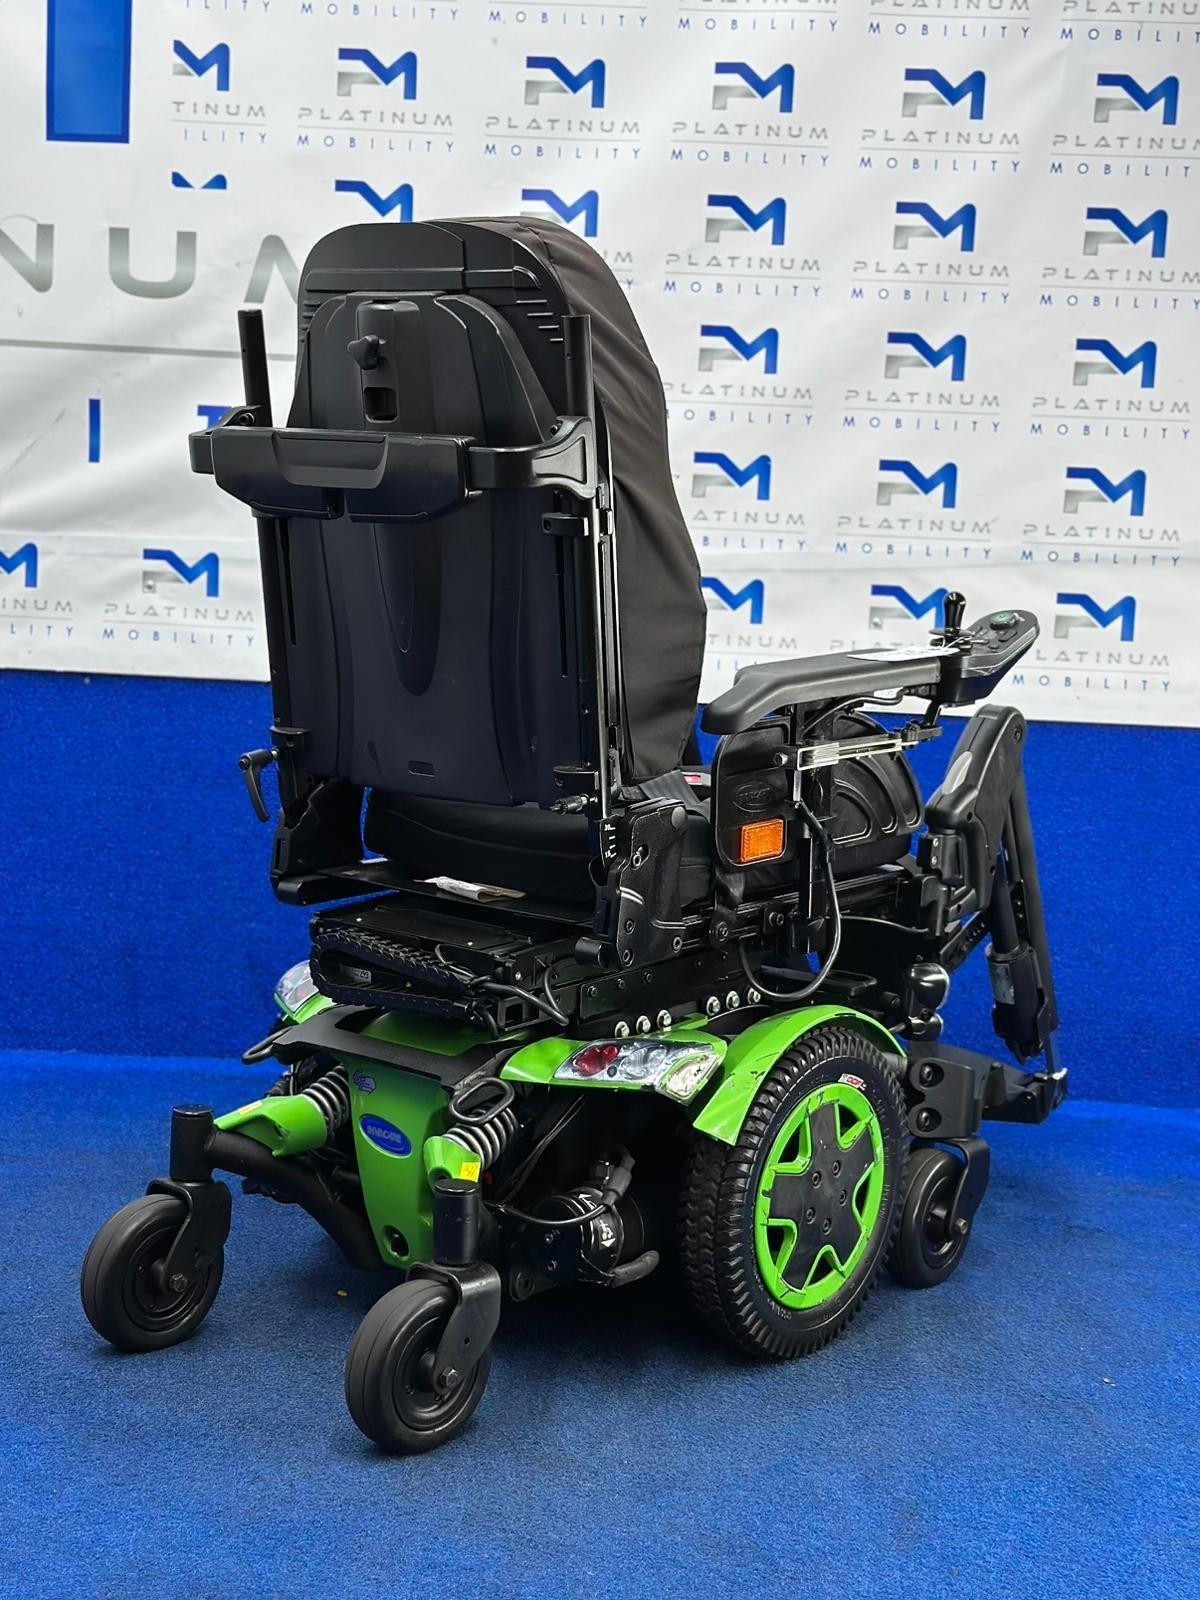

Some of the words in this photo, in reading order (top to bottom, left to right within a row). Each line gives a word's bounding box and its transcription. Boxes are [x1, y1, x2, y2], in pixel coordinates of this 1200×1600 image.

[300, 2, 458, 20] MOBILITY
[488, 11, 647, 28] MOBILITY
[678, 17, 838, 32] MOBILITY
[868, 21, 1030, 39] MOBILITY
[298, 107, 452, 126] PLATINUM
[485, 116, 639, 133] PLATINUM
[672, 122, 828, 139] PLATINUM
[861, 129, 1019, 145] PLATINUM
[297, 134, 454, 152] MOBILITY
[484, 143, 640, 159] MOBILITY
[670, 149, 829, 167] MOBILITY
[859, 156, 1020, 172] MOBILITY
[666, 253, 820, 271] PLATINUM
[853, 261, 1009, 277] PLATINUM
[1042, 267, 1200, 283] PLATINUM
[664, 280, 821, 297] MOBILITY
[851, 288, 1009, 304] MOBILITY
[1039, 294, 1200, 310] MOBILITY
[845, 390, 1000, 407] PLATINUM
[1032, 397, 1190, 413] PLATINUM
[842, 416, 1000, 432] MOBILITY
[1030, 423, 1190, 440] MOBILITY
[837, 516, 991, 533] PLATINUM
[1023, 524, 1179, 541] PLATINUM
[835, 542, 991, 560] MOBILITY
[1020, 547, 1183, 570] MOBILITY
[104, 603, 253, 621] PLATINUM
[102, 628, 253, 646] MOBILITY
[1012, 674, 1170, 692] MOBILITY
